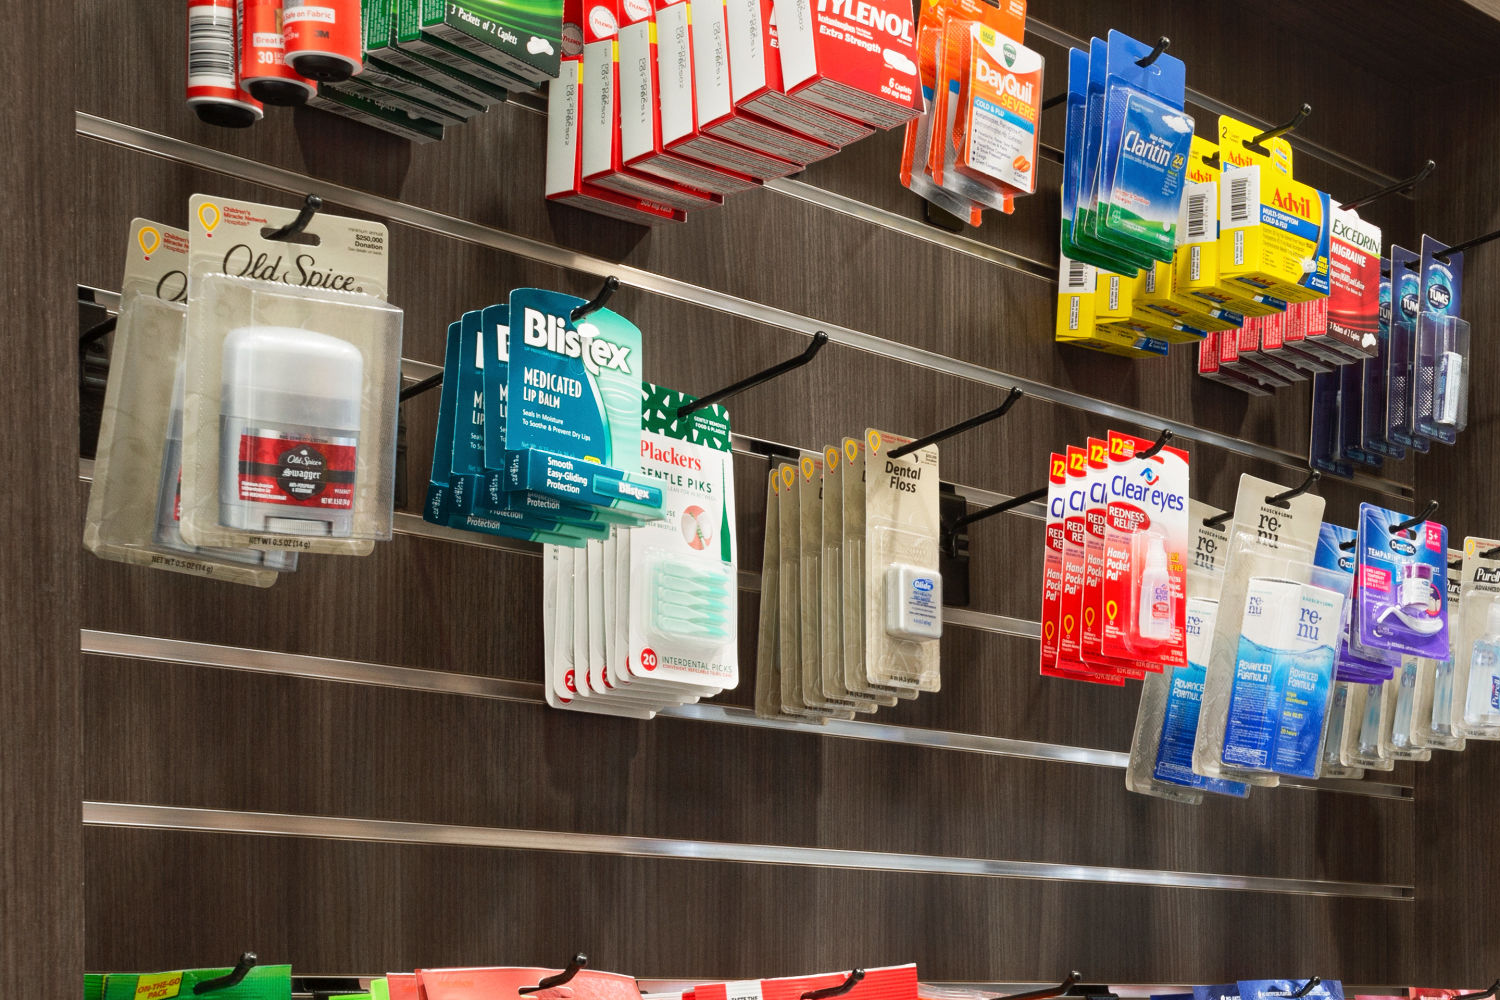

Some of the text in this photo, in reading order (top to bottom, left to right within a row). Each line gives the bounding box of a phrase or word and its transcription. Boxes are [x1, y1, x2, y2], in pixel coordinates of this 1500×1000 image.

[450, 3, 518, 46] 3 Packets of 2 Caplets
[819, 25, 881, 53] Extra Strength
[258, 52, 273, 64] 30
[889, 78, 894, 88] 6
[976, 58, 1033, 104] DayQuil
[1001, 93, 1035, 120] SEVERE
[1222, 126, 1228, 138] 2
[1123, 131, 1171, 167] Claritin
[1173, 154, 1183, 164] 24
[1228, 152, 1253, 167] Advil
[1272, 188, 1310, 218] Advil
[1332, 219, 1380, 253] EXCEDRIN
[355, 241, 383, 251] Donation
[1331, 242, 1366, 268] MIGRAINE
[222, 244, 355, 293] Old Spice
[1429, 290, 1449, 303] TUMS
[524, 306, 632, 376] Blistex
[524, 367, 582, 399] MEDICATED
[523, 386, 560, 409] LIP BALM
[523, 409, 535, 417] Seals
[542, 413, 563, 424] Moisture
[1091, 446, 1102, 462] 12
[1112, 438, 1123, 455] 12
[548, 457, 573, 470] Smooth
[641, 440, 702, 471] Plackers
[1071, 454, 1083, 469] 12
[548, 468, 587, 486] Easy-Gliding
[885, 462, 921, 481] Dental
[547, 481, 580, 494] Protection
[619, 482, 650, 499] Blistex
[688, 478, 712, 493] PIKS
[889, 477, 916, 493] Floss
[1111, 475, 1184, 512] Clear eyes
[527, 496, 560, 511] Protection
[1109, 505, 1145, 523] REDNESS
[466, 516, 501, 530] Protection
[1113, 515, 1139, 531] RELIEF
[1428, 530, 1439, 540] 5+
[1107, 547, 1130, 563] Handy
[1391, 542, 1414, 554] DenTek
[1106, 558, 1130, 573] Pocket
[1477, 569, 1500, 582] Purell
[1296, 622, 1320, 641] nu
[643, 653, 656, 667] 20
[1239, 660, 1272, 673] ADVANCED
[1237, 669, 1268, 682] FORMULA
[1290, 667, 1319, 682] ADVANCED
[1288, 676, 1315, 691] FORMULA
[1491, 678, 1500, 708] Purell
[137, 977, 181, 995] ON-THE-GO
[147, 987, 169, 999] PACK
